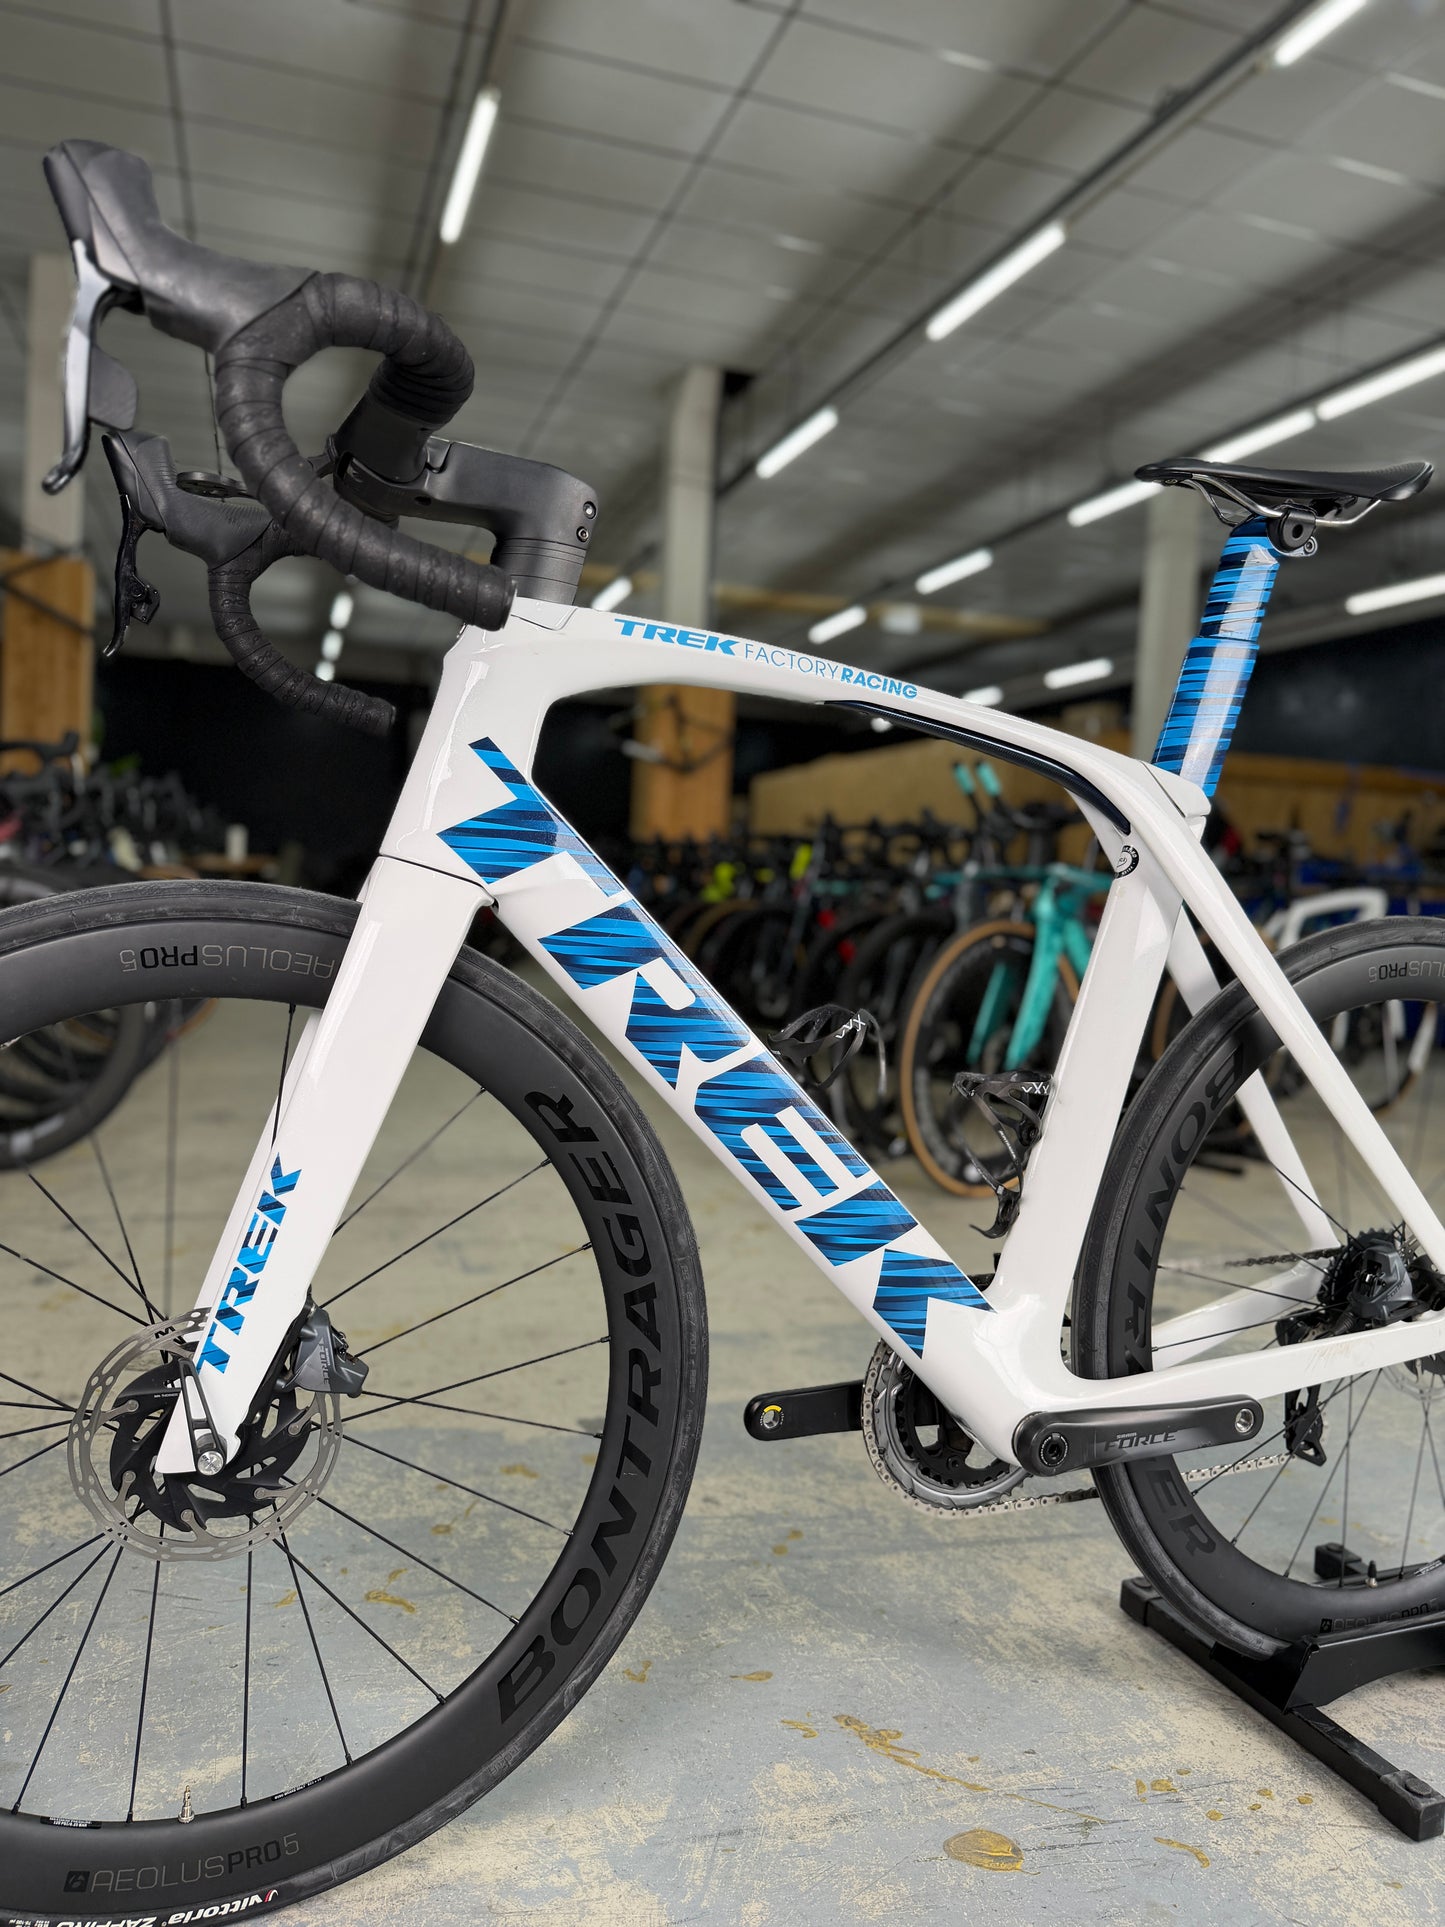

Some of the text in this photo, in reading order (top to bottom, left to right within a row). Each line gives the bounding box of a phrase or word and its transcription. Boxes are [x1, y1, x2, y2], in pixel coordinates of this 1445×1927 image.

[614, 618, 918, 700] TREK FACTORY RACING
[437, 737, 992, 1360] TREK
[195, 1152, 302, 1374] TREK
[319, 1343, 331, 1385] FORCE
[497, 1090, 662, 1725] BONTRAGER
[1103, 1432, 1177, 1452] FORCE
[168, 1893, 264, 1926] vittoria
